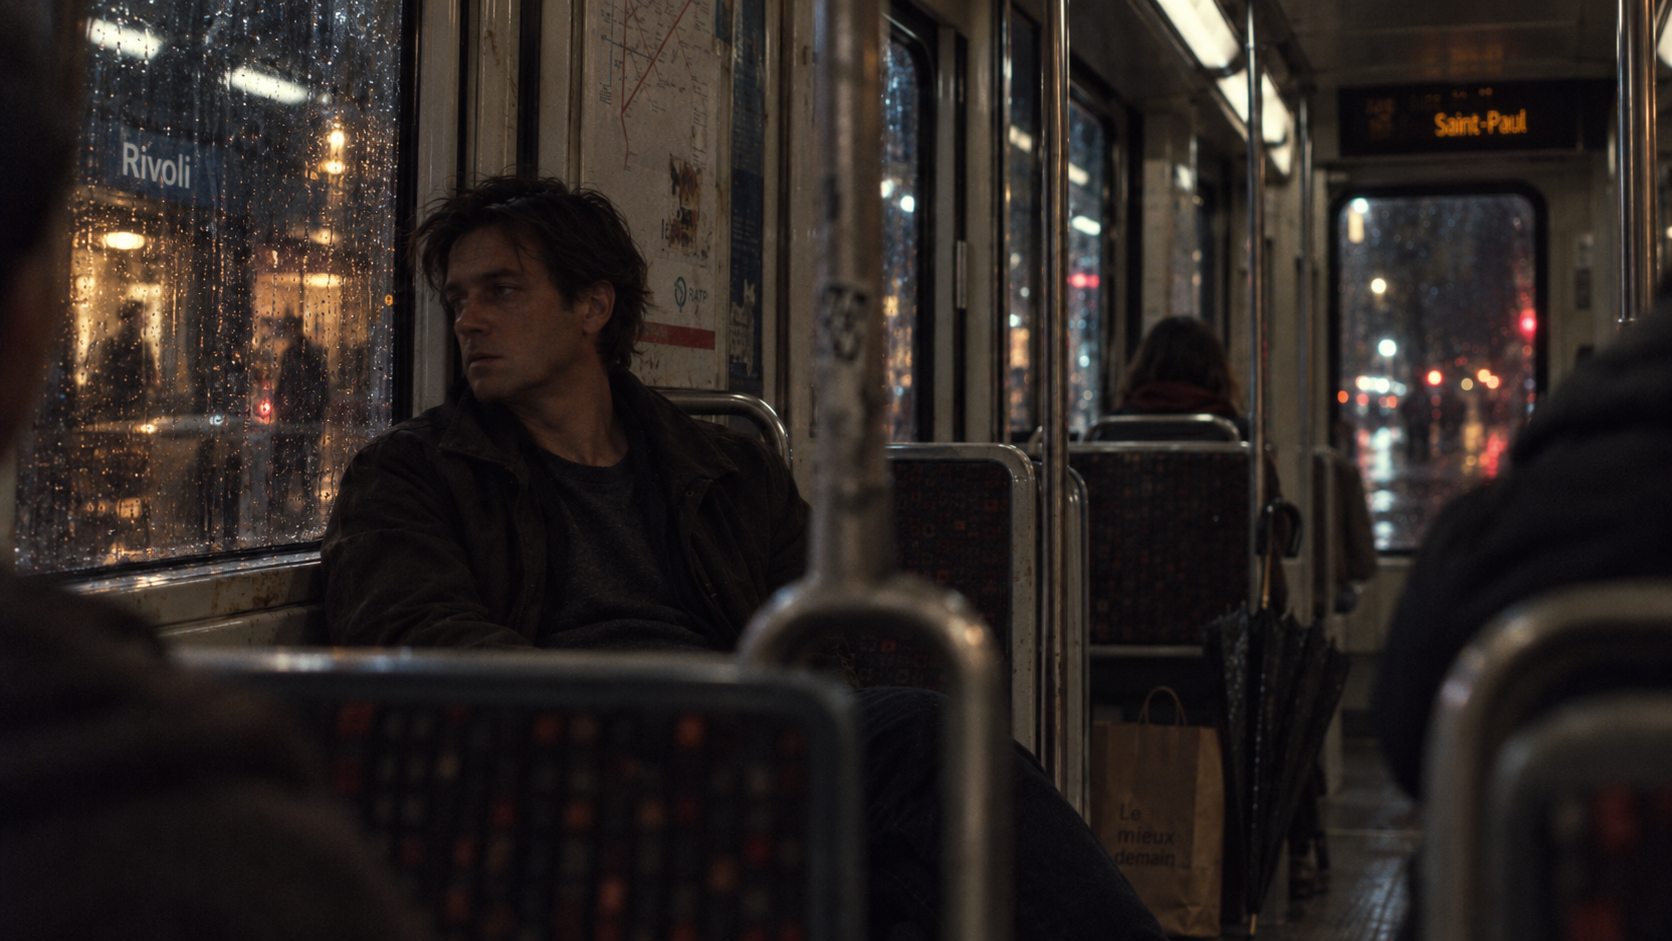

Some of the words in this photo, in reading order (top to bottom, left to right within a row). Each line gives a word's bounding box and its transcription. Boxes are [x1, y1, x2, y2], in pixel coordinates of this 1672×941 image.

[1434, 108, 1528, 138] Saint-Paul
[122, 141, 191, 189] Rivoli
[689, 287, 708, 304] RATP
[1120, 803, 1141, 822] Le
[1117, 826, 1176, 846] mieux
[1115, 848, 1176, 867] demain
